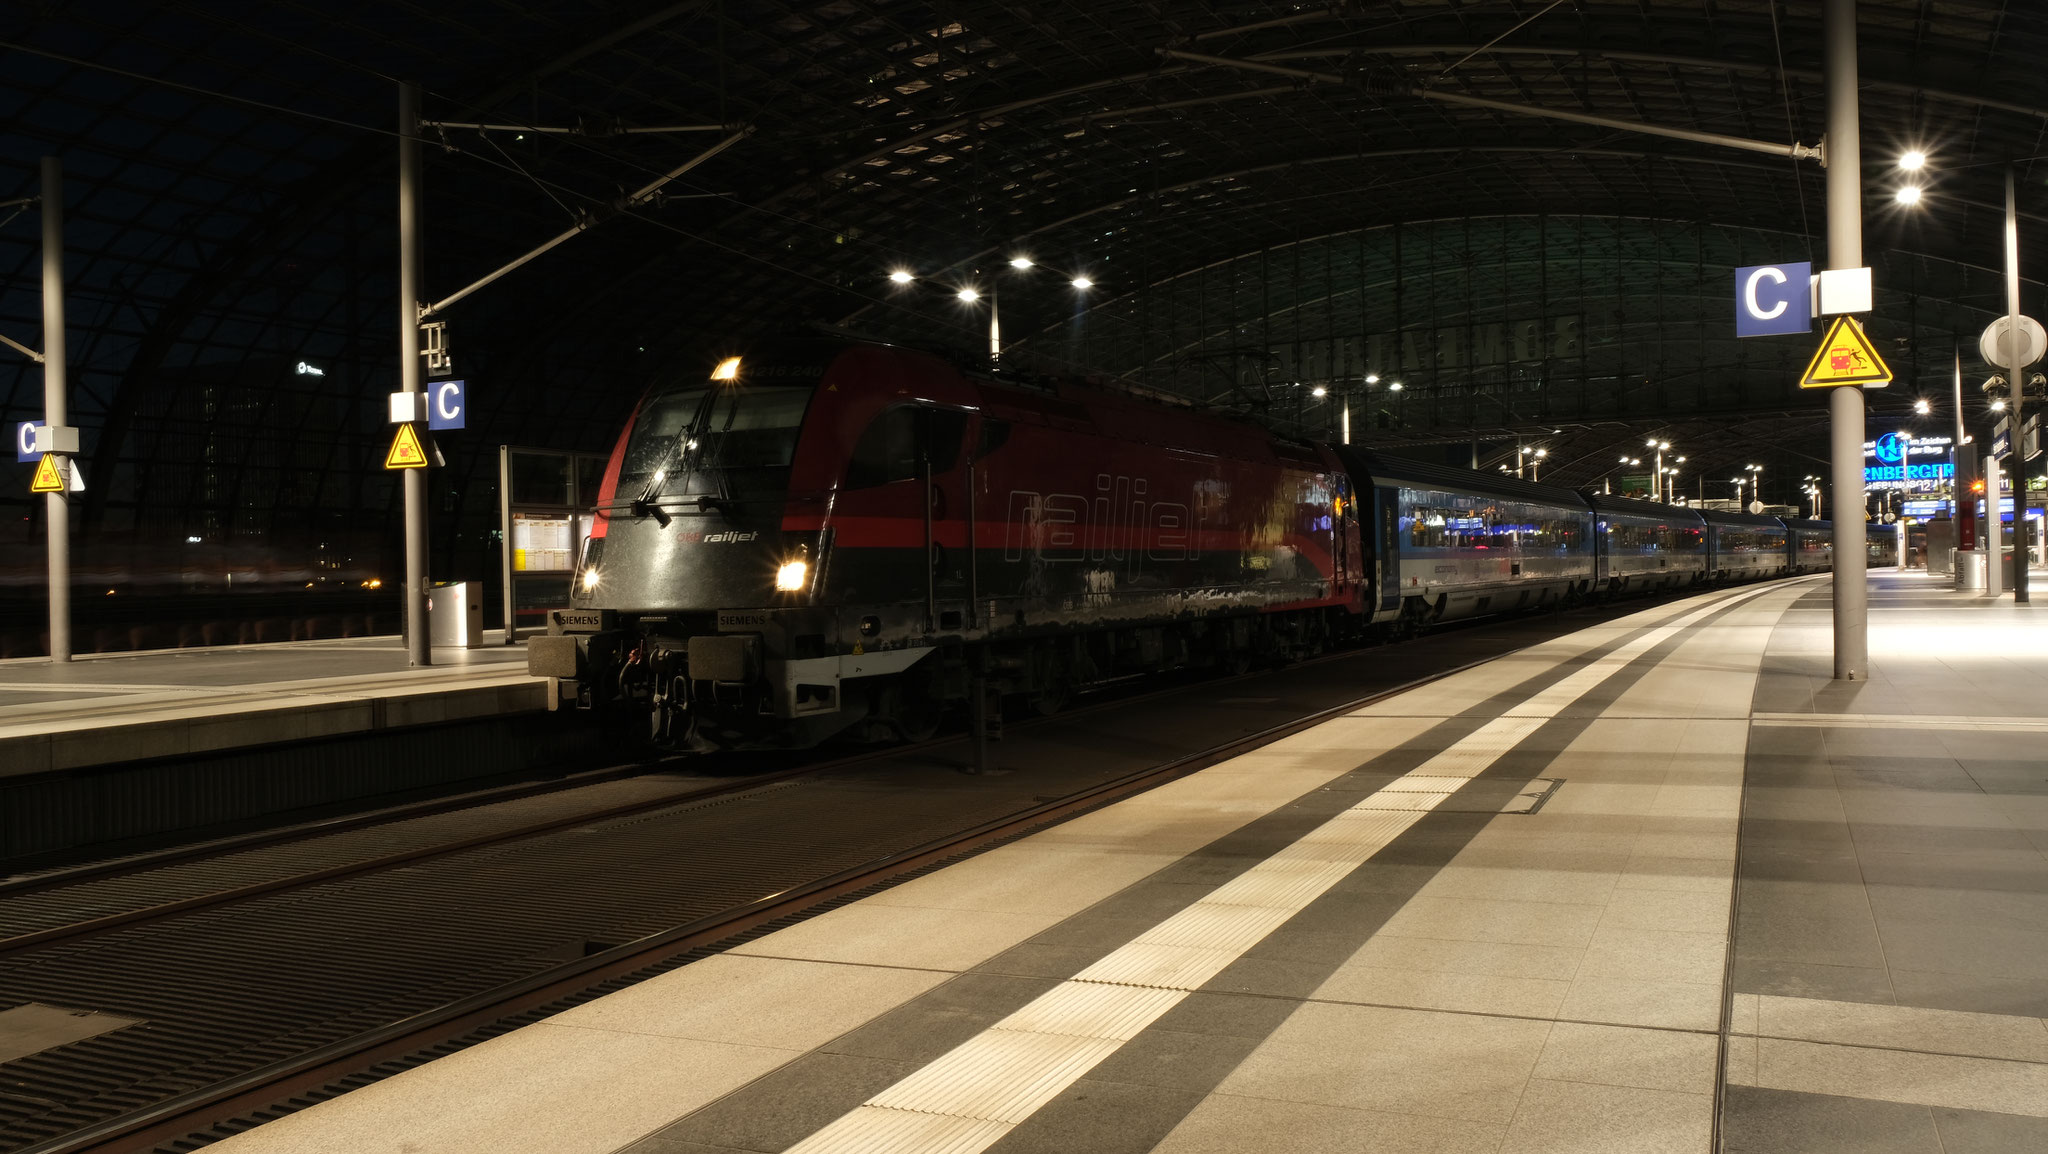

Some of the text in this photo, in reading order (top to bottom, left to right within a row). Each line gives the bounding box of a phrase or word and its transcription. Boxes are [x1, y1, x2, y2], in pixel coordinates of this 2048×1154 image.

[1744, 267, 1789, 320] C
[438, 382, 460, 420] C
[20, 422, 36, 454] C
[703, 530, 759, 544] railjet
[1004, 473, 1209, 585] railjet
[561, 615, 599, 625] SIEMENS
[720, 615, 765, 625] SIEMENS
